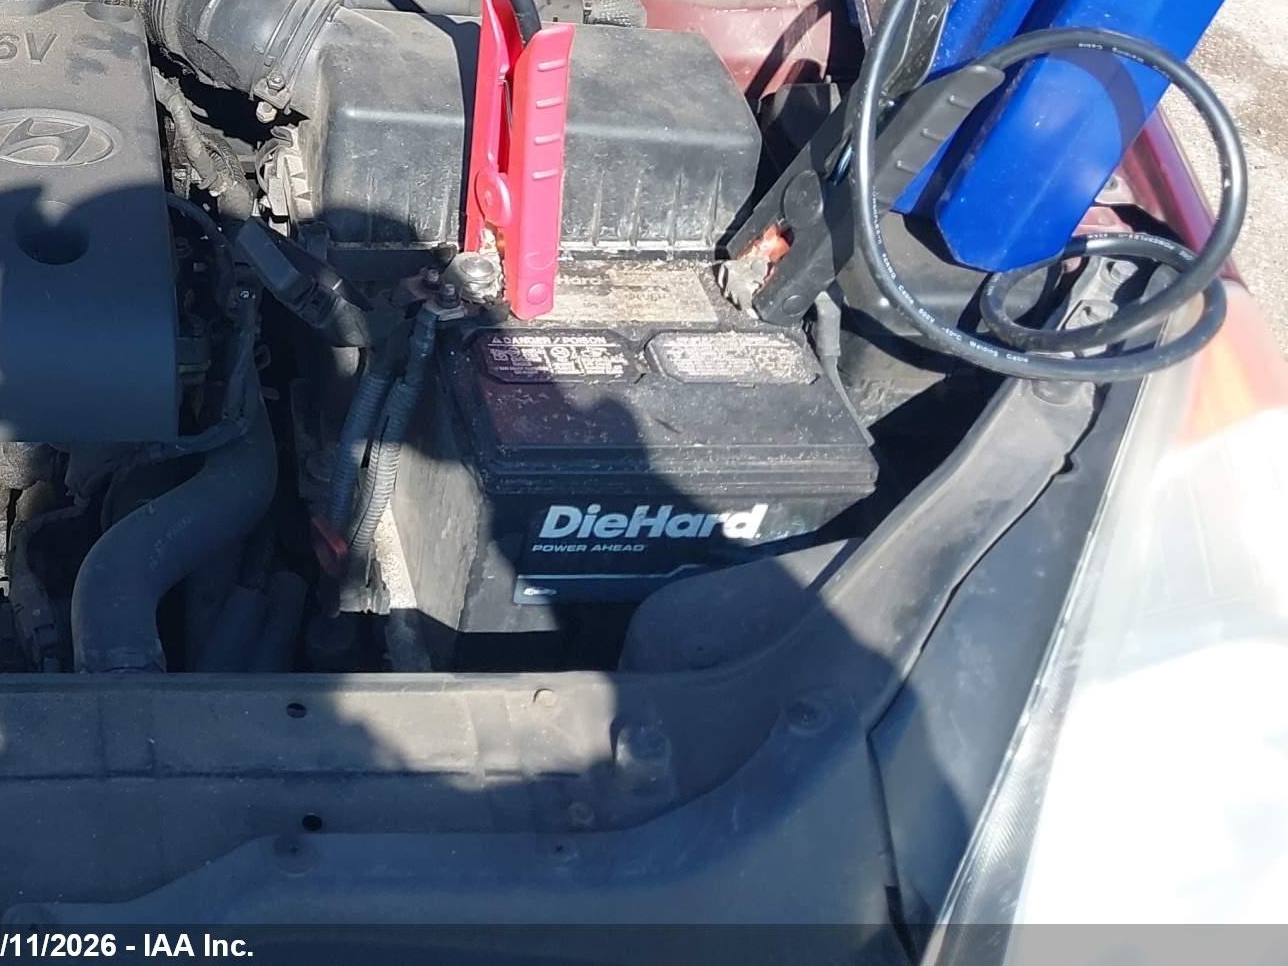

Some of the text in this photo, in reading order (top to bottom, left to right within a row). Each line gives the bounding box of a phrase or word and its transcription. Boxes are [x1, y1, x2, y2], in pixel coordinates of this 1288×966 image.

[539, 503, 768, 539] DieHard
[531, 543, 645, 553] POWER AHEAD
